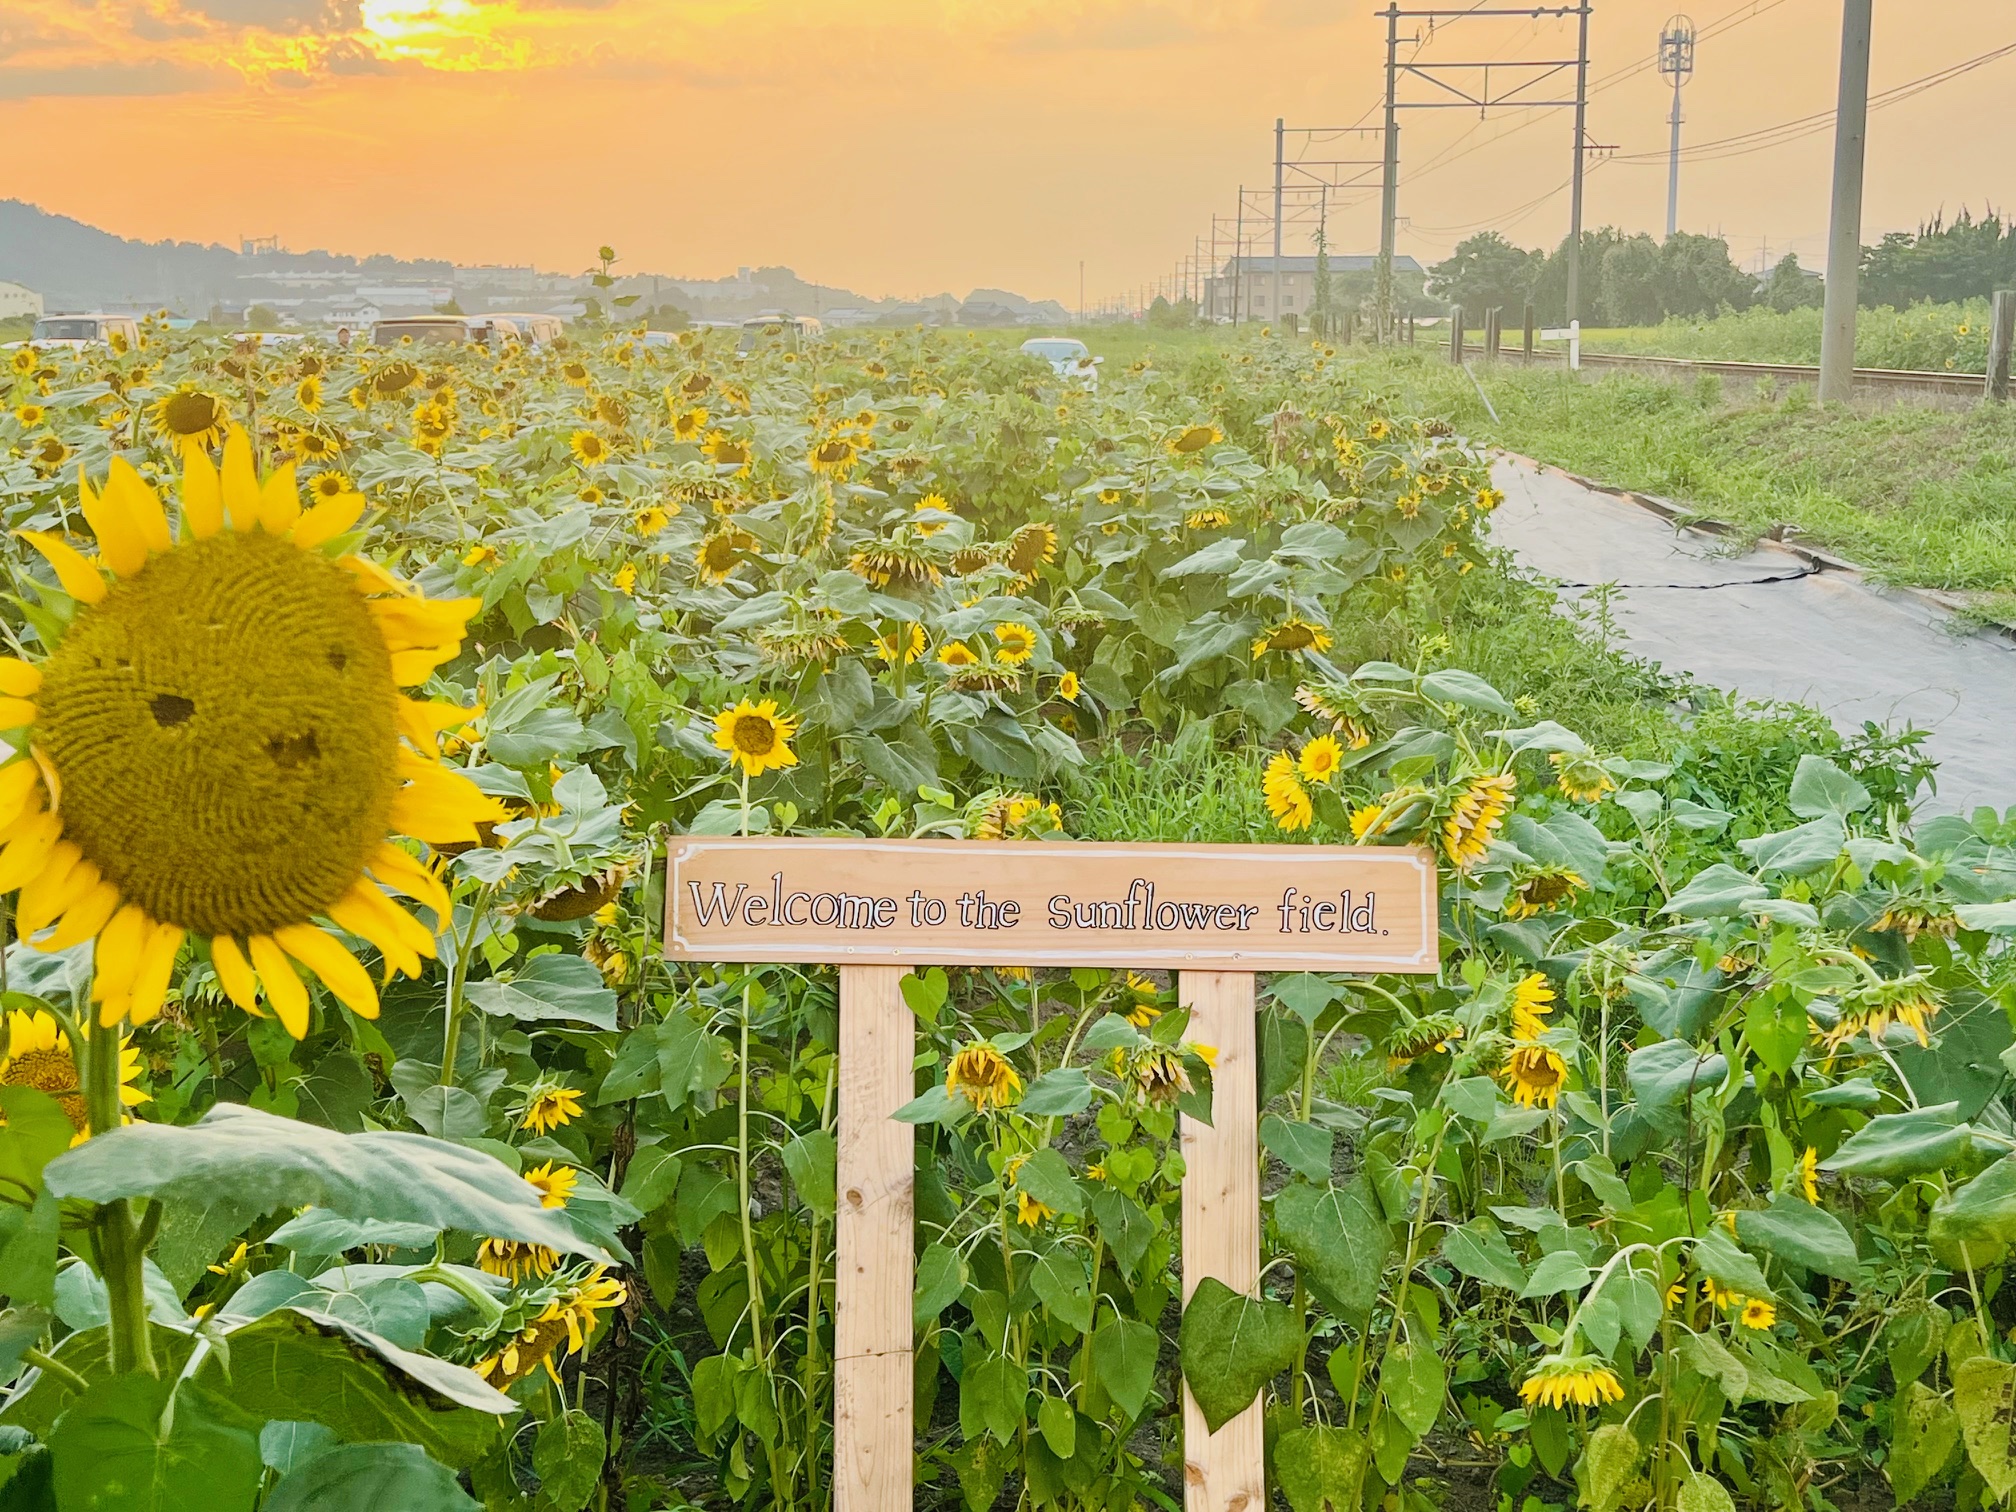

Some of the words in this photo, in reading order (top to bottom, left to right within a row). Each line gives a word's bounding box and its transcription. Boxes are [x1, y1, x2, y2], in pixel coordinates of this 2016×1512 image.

[687, 871, 897, 930] Welcome
[906, 890, 947, 927] to
[955, 890, 1021, 930] the
[1047, 878, 1258, 931] Sunflower
[1277, 887, 1389, 936] field.
